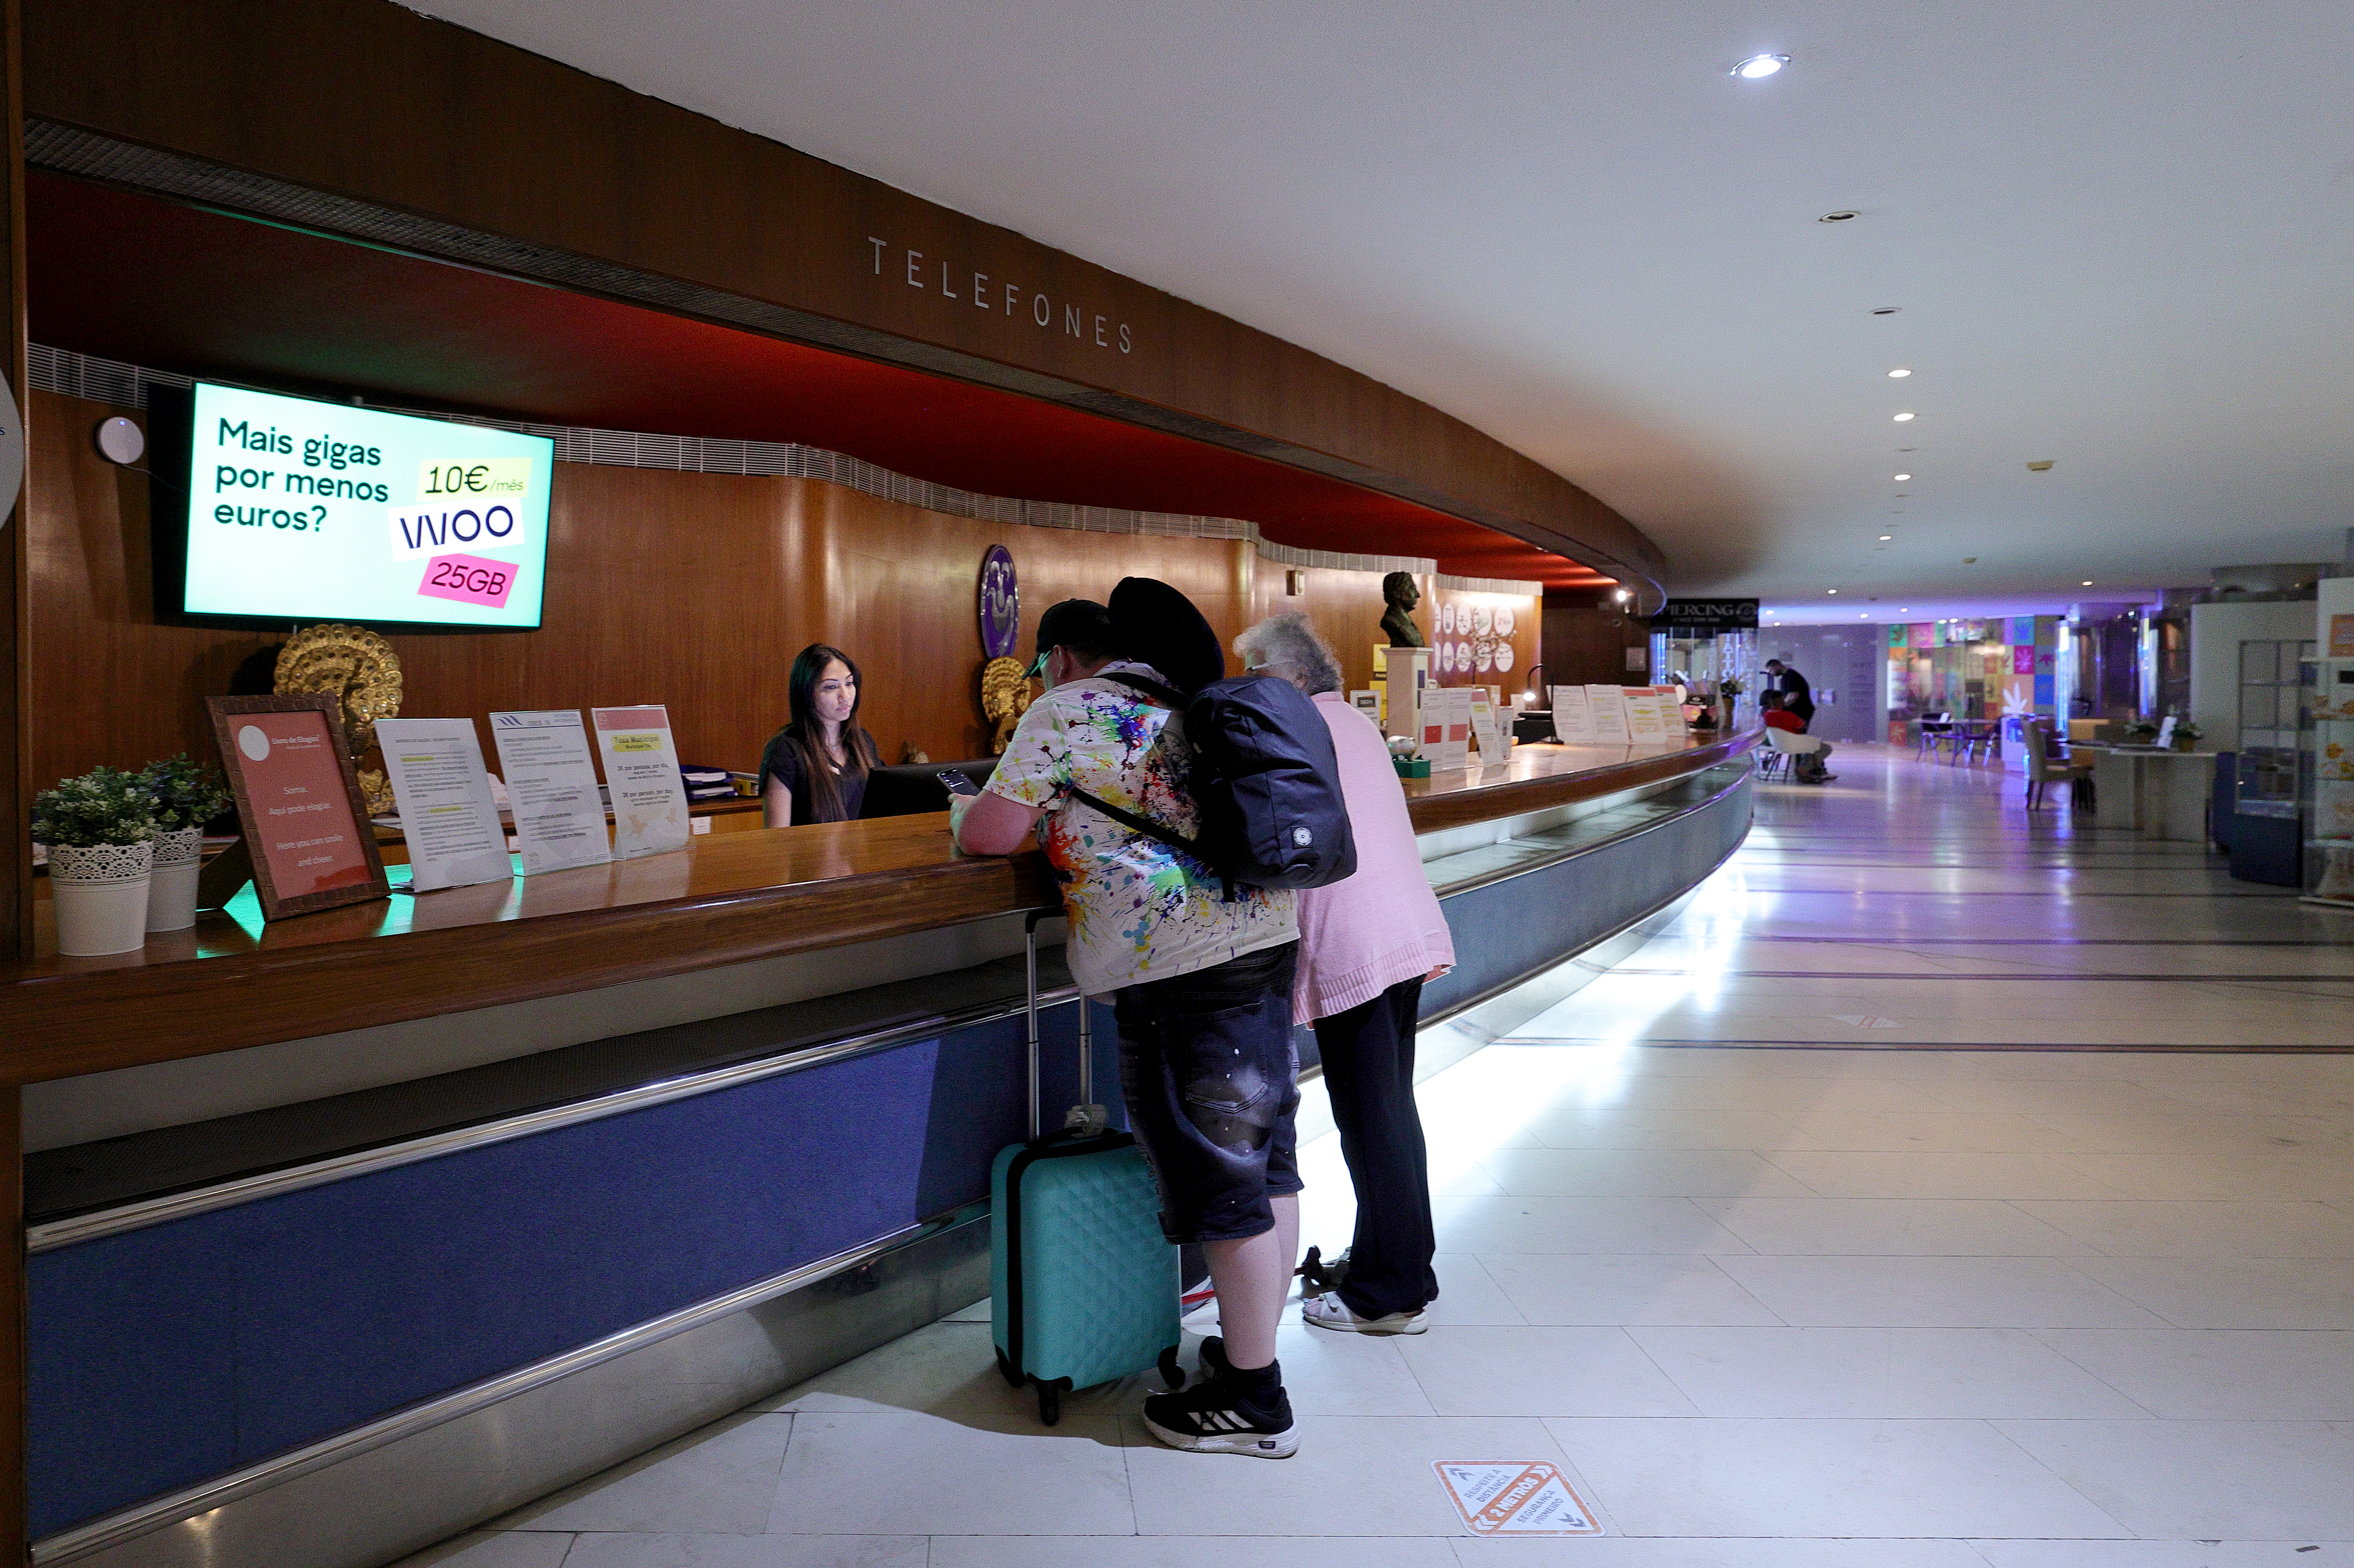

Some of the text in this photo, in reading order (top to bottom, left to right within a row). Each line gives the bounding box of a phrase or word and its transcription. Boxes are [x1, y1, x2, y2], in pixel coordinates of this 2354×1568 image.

[868, 236, 1131, 354] TELEFONES
[218, 417, 382, 470] Mais gigas
[216, 464, 389, 503] por menos
[214, 504, 328, 532] euros?
[400, 505, 513, 549] WOO
[431, 562, 507, 596] 25GB
[1464, 1473, 1496, 1498] RESPEITE
[1489, 1477, 1540, 1518] 2 METROS
[1533, 1498, 1564, 1524] PRIMEIRO
